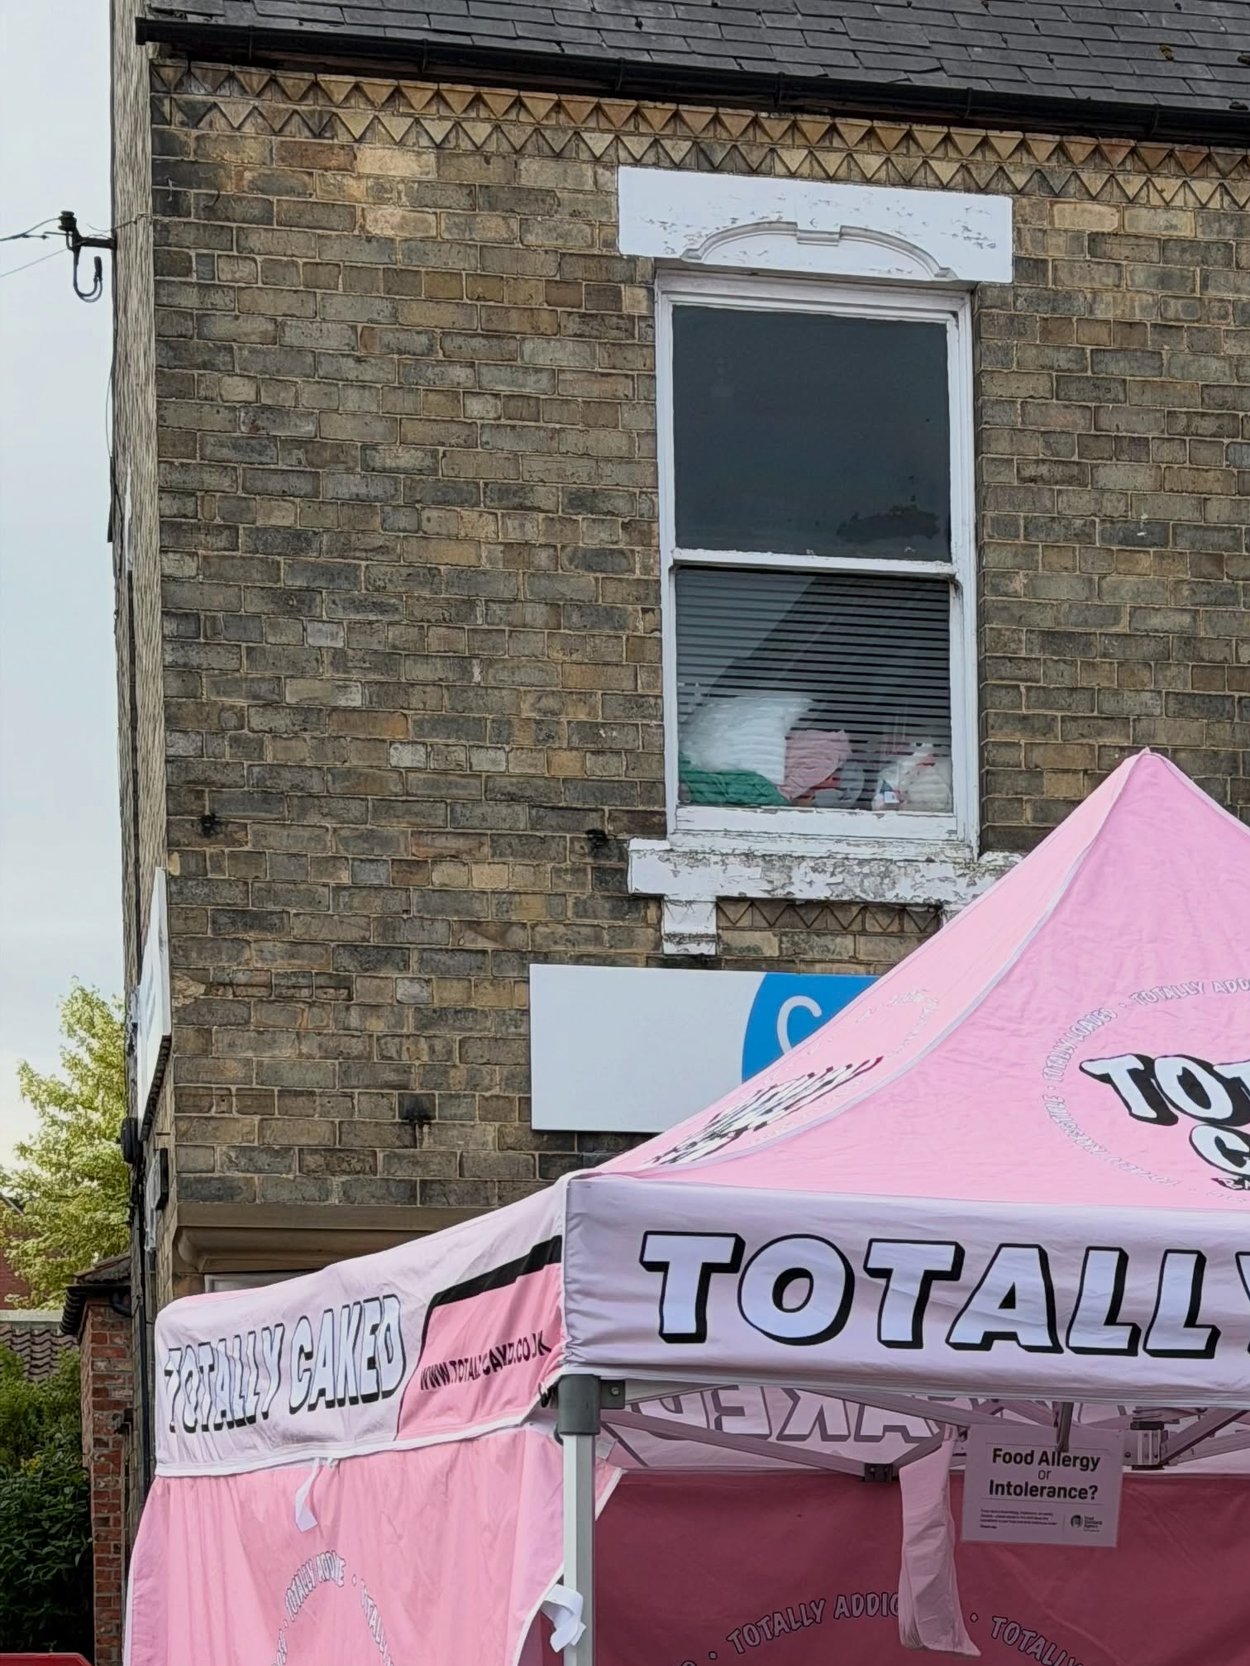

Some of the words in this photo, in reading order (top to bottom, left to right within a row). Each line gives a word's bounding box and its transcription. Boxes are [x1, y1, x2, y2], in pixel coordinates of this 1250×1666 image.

[1128, 980, 1204, 1008] TOTALLY
[164, 1322, 286, 1434] TOTALLY
[289, 1294, 407, 1415] CAKED
[992, 1448, 1035, 1465] Food
[1037, 1450, 1101, 1472] Allergy
[1037, 1469, 1052, 1480] or
[988, 1479, 1099, 1501] Intolerance?
[726, 1598, 826, 1655] TOTALLY
